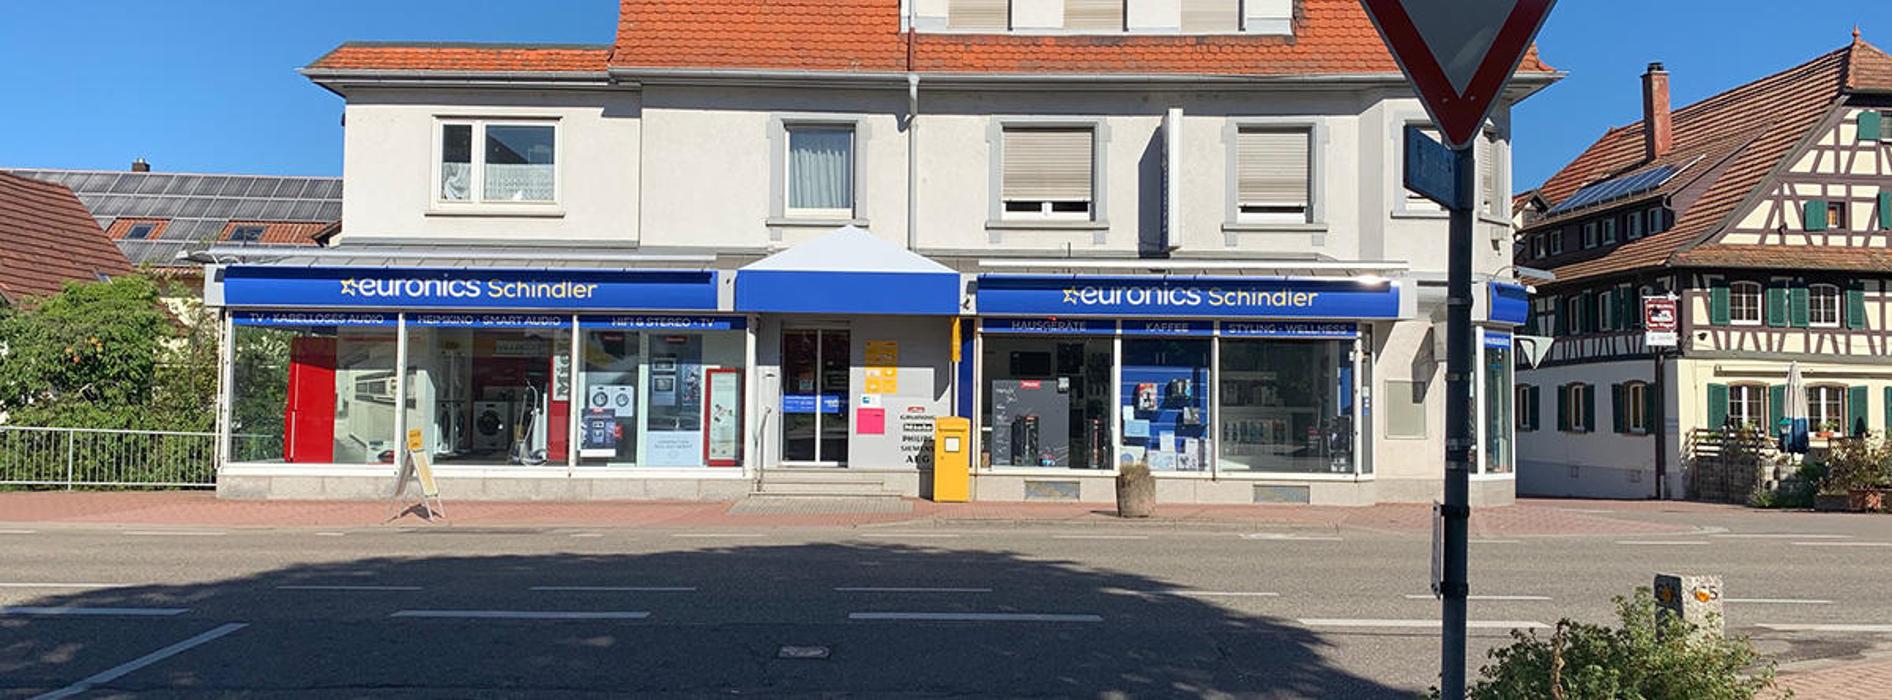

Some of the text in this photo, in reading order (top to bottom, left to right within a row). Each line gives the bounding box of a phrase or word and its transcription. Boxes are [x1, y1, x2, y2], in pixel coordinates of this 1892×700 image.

[359, 274, 598, 299] euronics Schindler
[1080, 282, 1319, 307] euronics Schindler
[250, 313, 385, 324] TV KABELLOSES AUDIO
[417, 315, 561, 326] HEIMKINO SMART AUDIO
[646, 317, 691, 327] STEREO
[700, 318, 716, 328] TV
[1011, 319, 1086, 332] HAUSGERÄTE
[1145, 322, 1189, 333] KAFFEE
[1228, 324, 1348, 335] STYLING WELLNESS
